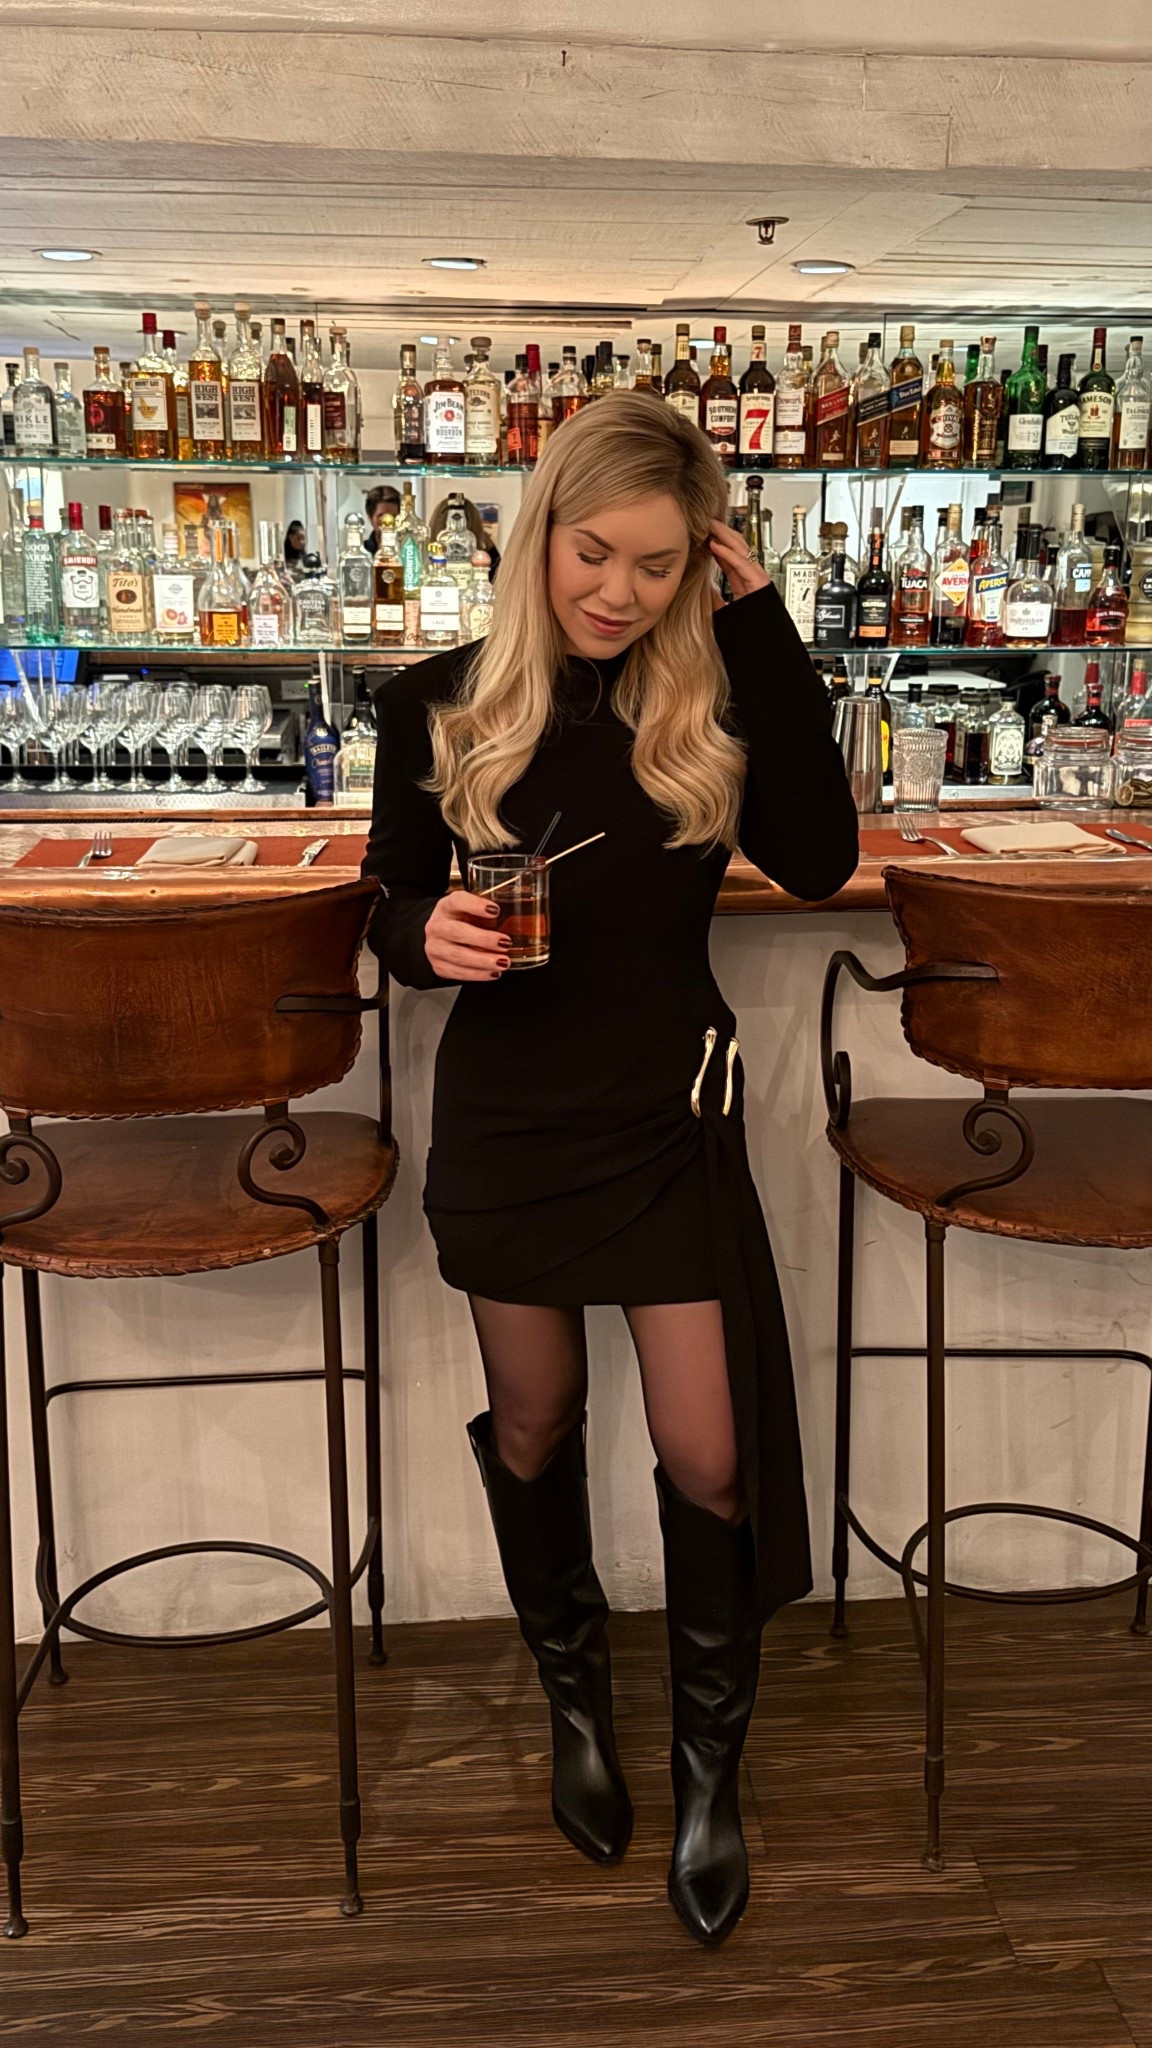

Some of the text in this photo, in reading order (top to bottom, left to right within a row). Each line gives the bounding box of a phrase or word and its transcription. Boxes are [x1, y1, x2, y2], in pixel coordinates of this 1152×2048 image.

[754, 346, 763, 358] 7
[194, 384, 218, 394] HIGH
[231, 385, 255, 395] HIGH
[195, 393, 219, 401] WEST
[232, 394, 256, 402] WEST
[433, 400, 447, 413] JIM
[744, 409, 770, 450] 7
[405, 544, 414, 585] HORNITOS
[112, 577, 139, 588] Tito's
[901, 577, 928, 589] TUACA
